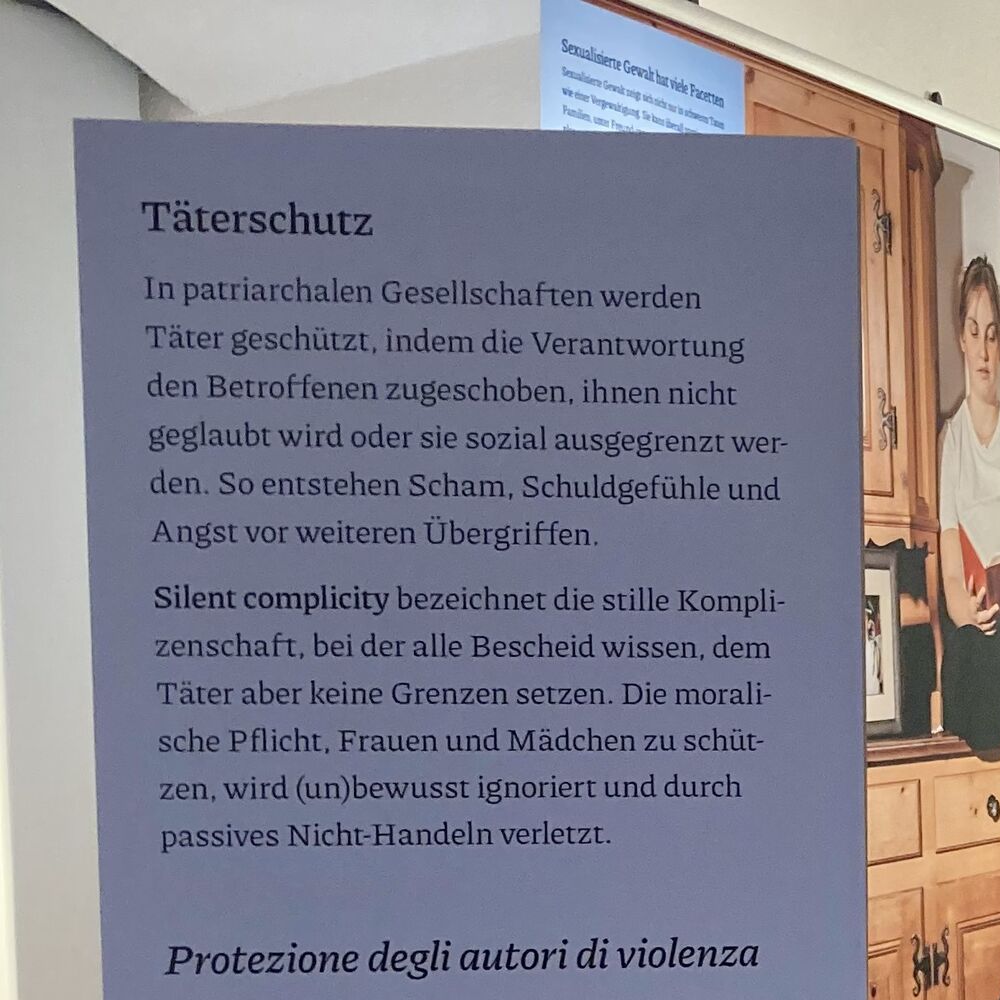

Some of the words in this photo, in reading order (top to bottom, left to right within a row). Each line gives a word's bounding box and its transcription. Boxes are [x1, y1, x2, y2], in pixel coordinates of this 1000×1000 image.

[562, 38, 622, 70] Sexualisierte
[623, 60, 654, 82] Gewalt
[656, 69, 669, 87] hat
[670, 77, 688, 95] viele
[690, 83, 724, 108] Facetten
[140, 199, 374, 237] Täterschutz
[143, 276, 176, 300] In
[182, 276, 373, 307] patriarchalen
[381, 279, 594, 308] Gesellschaften
[599, 283, 702, 310] werden
[144, 324, 225, 350] Täter
[231, 324, 377, 357] geschützt,
[386, 327, 475, 354] indem
[481, 328, 524, 355] die
[530, 331, 746, 365] Verantwortung
[147, 371, 198, 398] den
[206, 372, 379, 401] Betroffenen
[385, 376, 574, 408] zugeschoben,
[582, 378, 662, 405] ihnen
[668, 380, 738, 406] nicht
[148, 420, 272, 453] geglaubt
[277, 422, 344, 449] wird
[350, 422, 414, 449] oder
[420, 424, 458, 450] sie
[465, 425, 548, 451] sozial
[554, 430, 725, 459] ausgegrenzt
[730, 435, 789, 454] wer-
[149, 468, 209, 495] den.
[218, 471, 255, 496] So
[261, 470, 402, 497] entstehen
[408, 471, 514, 501] Scham,
[522, 473, 721, 506] Schuldgefühle
[727, 476, 781, 501] und
[151, 519, 239, 550] Angst
[244, 525, 289, 544] vor
[294, 519, 417, 545] weiteren
[422, 515, 599, 552] Übergriffen.
[154, 583, 237, 610] Silent
[243, 584, 390, 617] complicity
[396, 585, 548, 611] bezeichnet
[553, 585, 595, 612] die
[602, 586, 670, 612] stille
[677, 587, 786, 619] Kompli-
[163, 941, 360, 976] Protezione
[367, 939, 452, 981] degli
[459, 938, 569, 972] autori
[576, 937, 610, 970] di
[616, 936, 759, 969] violenza
